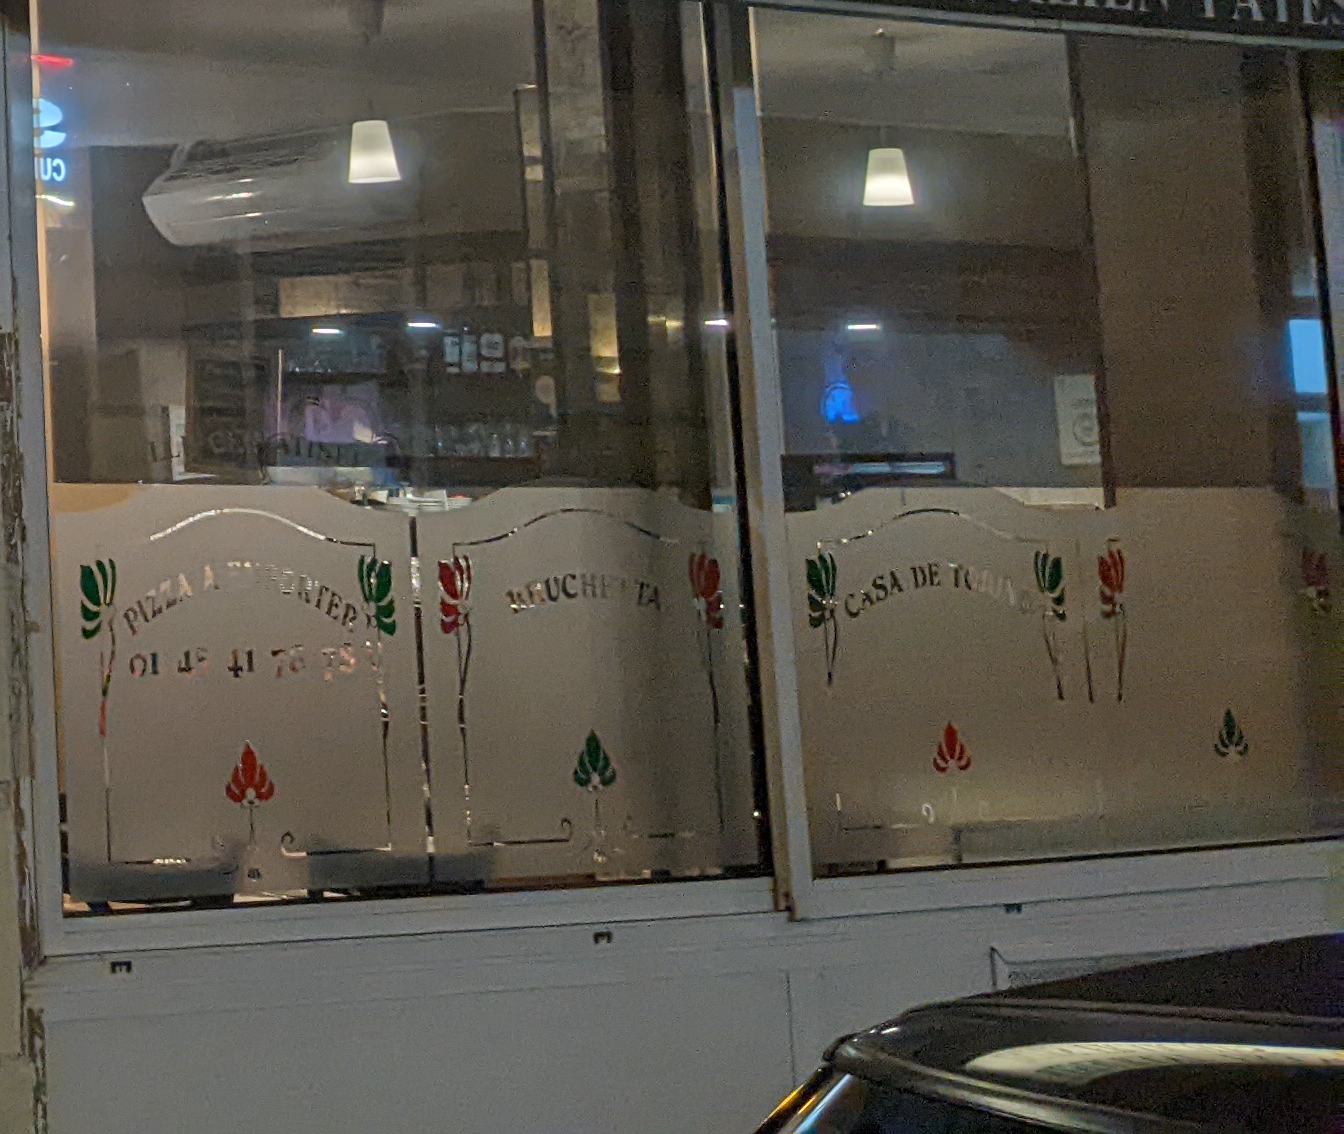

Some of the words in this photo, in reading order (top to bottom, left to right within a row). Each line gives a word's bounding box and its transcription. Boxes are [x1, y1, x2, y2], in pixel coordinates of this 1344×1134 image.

[123, 572, 193, 636] PIZZA
[844, 568, 904, 617] CASA
[911, 562, 942, 590] DE
[129, 652, 159, 677] 01
[227, 648, 256, 679] 41
